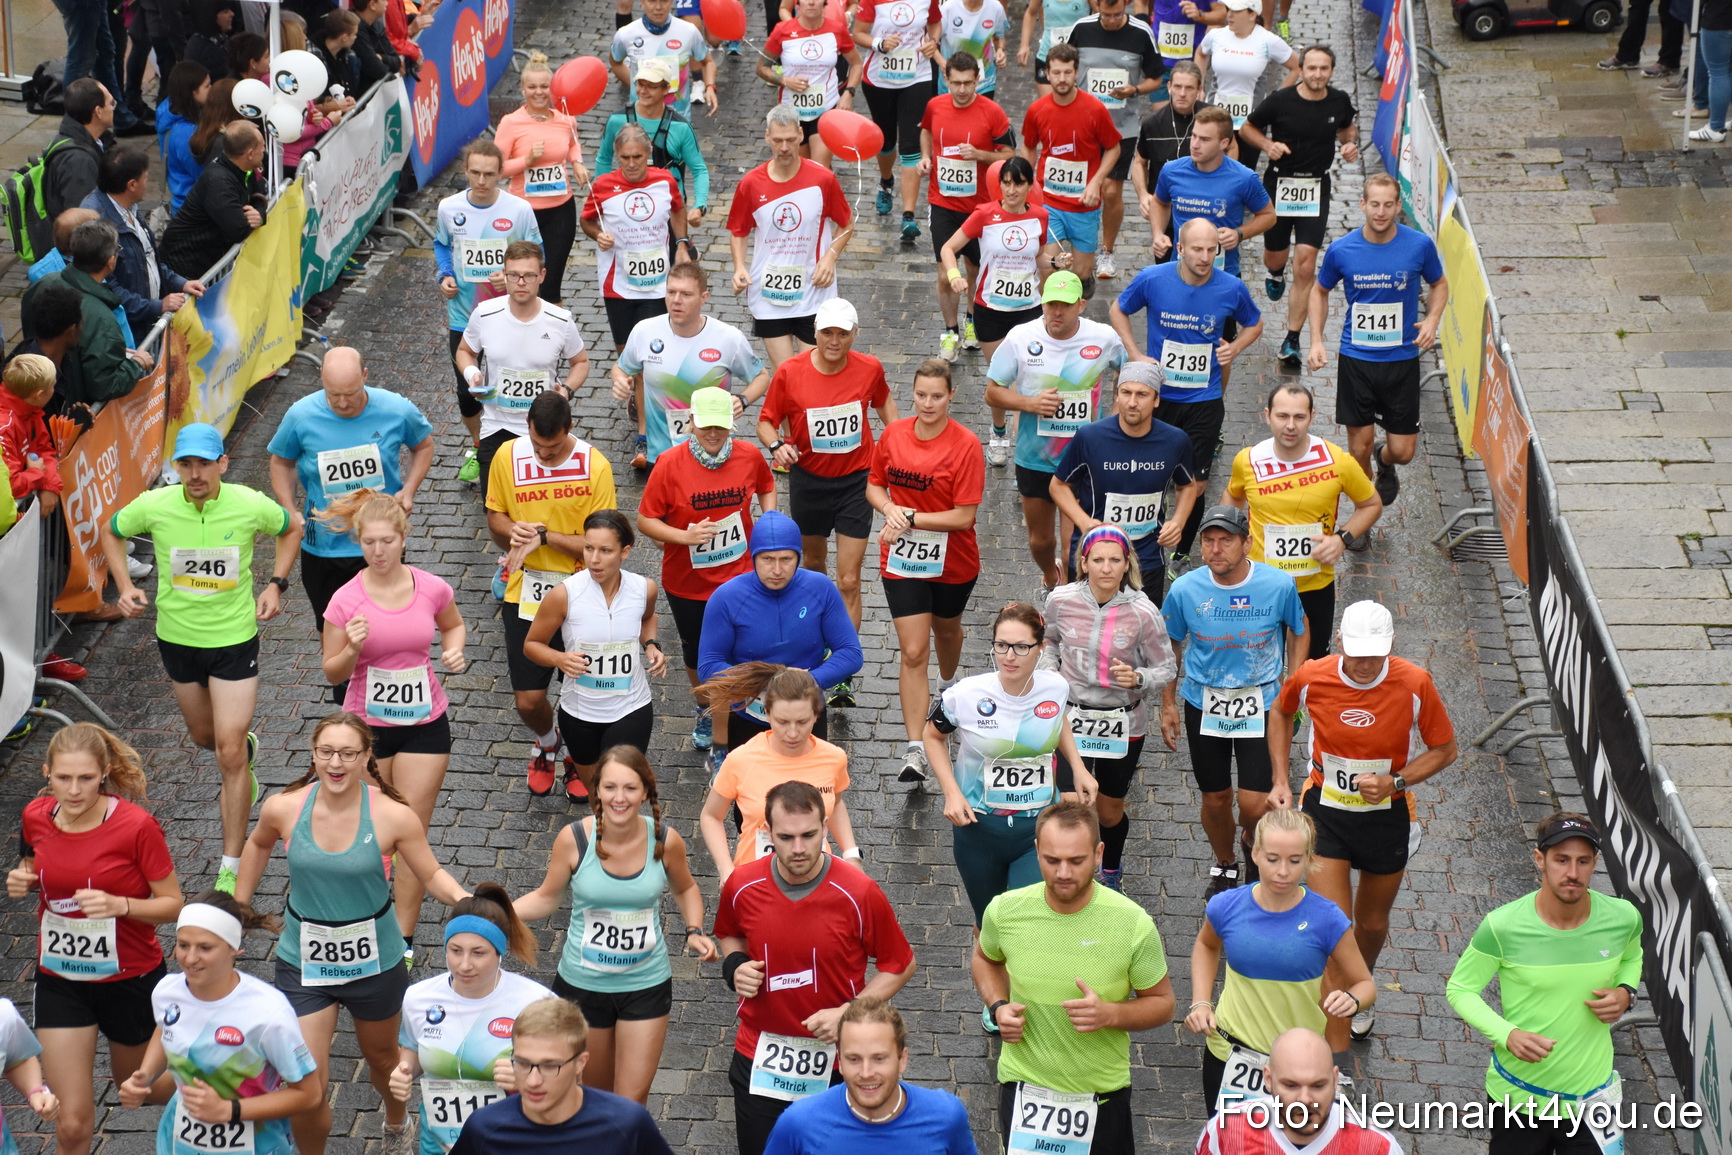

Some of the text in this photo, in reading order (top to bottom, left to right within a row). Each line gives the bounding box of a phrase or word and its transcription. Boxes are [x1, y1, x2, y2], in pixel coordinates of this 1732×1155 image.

[1165, 32, 1187, 46] 303
[452, 26, 485, 89] Hervis
[882, 56, 913, 71] 3017
[793, 93, 823, 107] 2030
[413, 79, 439, 148] Hervis
[528, 166, 563, 183] 2673
[940, 167, 973, 184] 2263
[1048, 167, 1083, 184] 2314
[1281, 186, 1315, 202] 2901
[1176, 205, 1212, 215] Pettenhofen
[1177, 197, 1211, 208] Kirwaläufer
[466, 248, 504, 266] 2466
[471, 269, 495, 277] Christi
[629, 258, 665, 277] 2049
[639, 279, 657, 287] Josef
[765, 273, 802, 291] 2226
[1353, 274, 1391, 282] Kirwaläufer
[1353, 282, 1393, 290] Pettenhofen
[771, 292, 795, 301] Rüdiger
[995, 280, 1032, 298] 2048
[1159, 319, 1199, 330] Pettenhofen
[1160, 312, 1199, 322] Kirwaläufer
[1357, 313, 1397, 330] 2141
[1367, 334, 1387, 342] Michi
[1165, 353, 1208, 371] 2139
[1175, 374, 1194, 382] Benni
[502, 378, 545, 397] 2285
[814, 414, 858, 437] 2078
[1050, 423, 1079, 431] Andreas
[829, 440, 848, 448] Erich
[326, 457, 378, 482] 2069
[1103, 461, 1165, 471] EURO POLES
[345, 482, 364, 491] Bubi
[1258, 470, 1340, 497] MAX BÖGL
[515, 489, 549, 505] MAX
[553, 485, 593, 503] BÖGL
[1110, 504, 1155, 523] 3108
[894, 537, 941, 561] 2754
[1275, 537, 1312, 557] 326
[708, 549, 734, 563] Andrea
[184, 558, 226, 577] 246
[901, 562, 928, 572] Nadine
[1278, 561, 1309, 570] Scherer
[190, 578, 220, 589] Tomas
[1213, 606, 1274, 618] firmenlauf
[1195, 631, 1235, 643] Gesunde
[584, 653, 633, 675] 2110
[595, 679, 615, 689] Nina
[372, 681, 424, 705] 2201
[384, 708, 415, 718] Marina
[1036, 705, 1058, 715] Hervis
[1209, 695, 1258, 719] 2723
[1071, 718, 1124, 738] 2724
[1218, 720, 1248, 731] Norbert
[1081, 740, 1110, 751] Sandra
[991, 765, 1046, 789] 2621
[1005, 792, 1035, 803] Margit
[48, 930, 111, 959] 2324
[590, 921, 648, 952] 2857
[308, 937, 372, 963] 2856
[61, 961, 98, 974] Marina
[597, 953, 638, 966] Stefanie
[320, 966, 362, 978] Rebecca
[782, 977, 802, 986] DEHN
[762, 1043, 828, 1077] 2589
[773, 1077, 808, 1093] Patrick
[1230, 1062, 1272, 1095] 20
[1021, 1102, 1090, 1138] 2799
[180, 1115, 246, 1148] 2282
[1034, 1138, 1067, 1154] Marco
